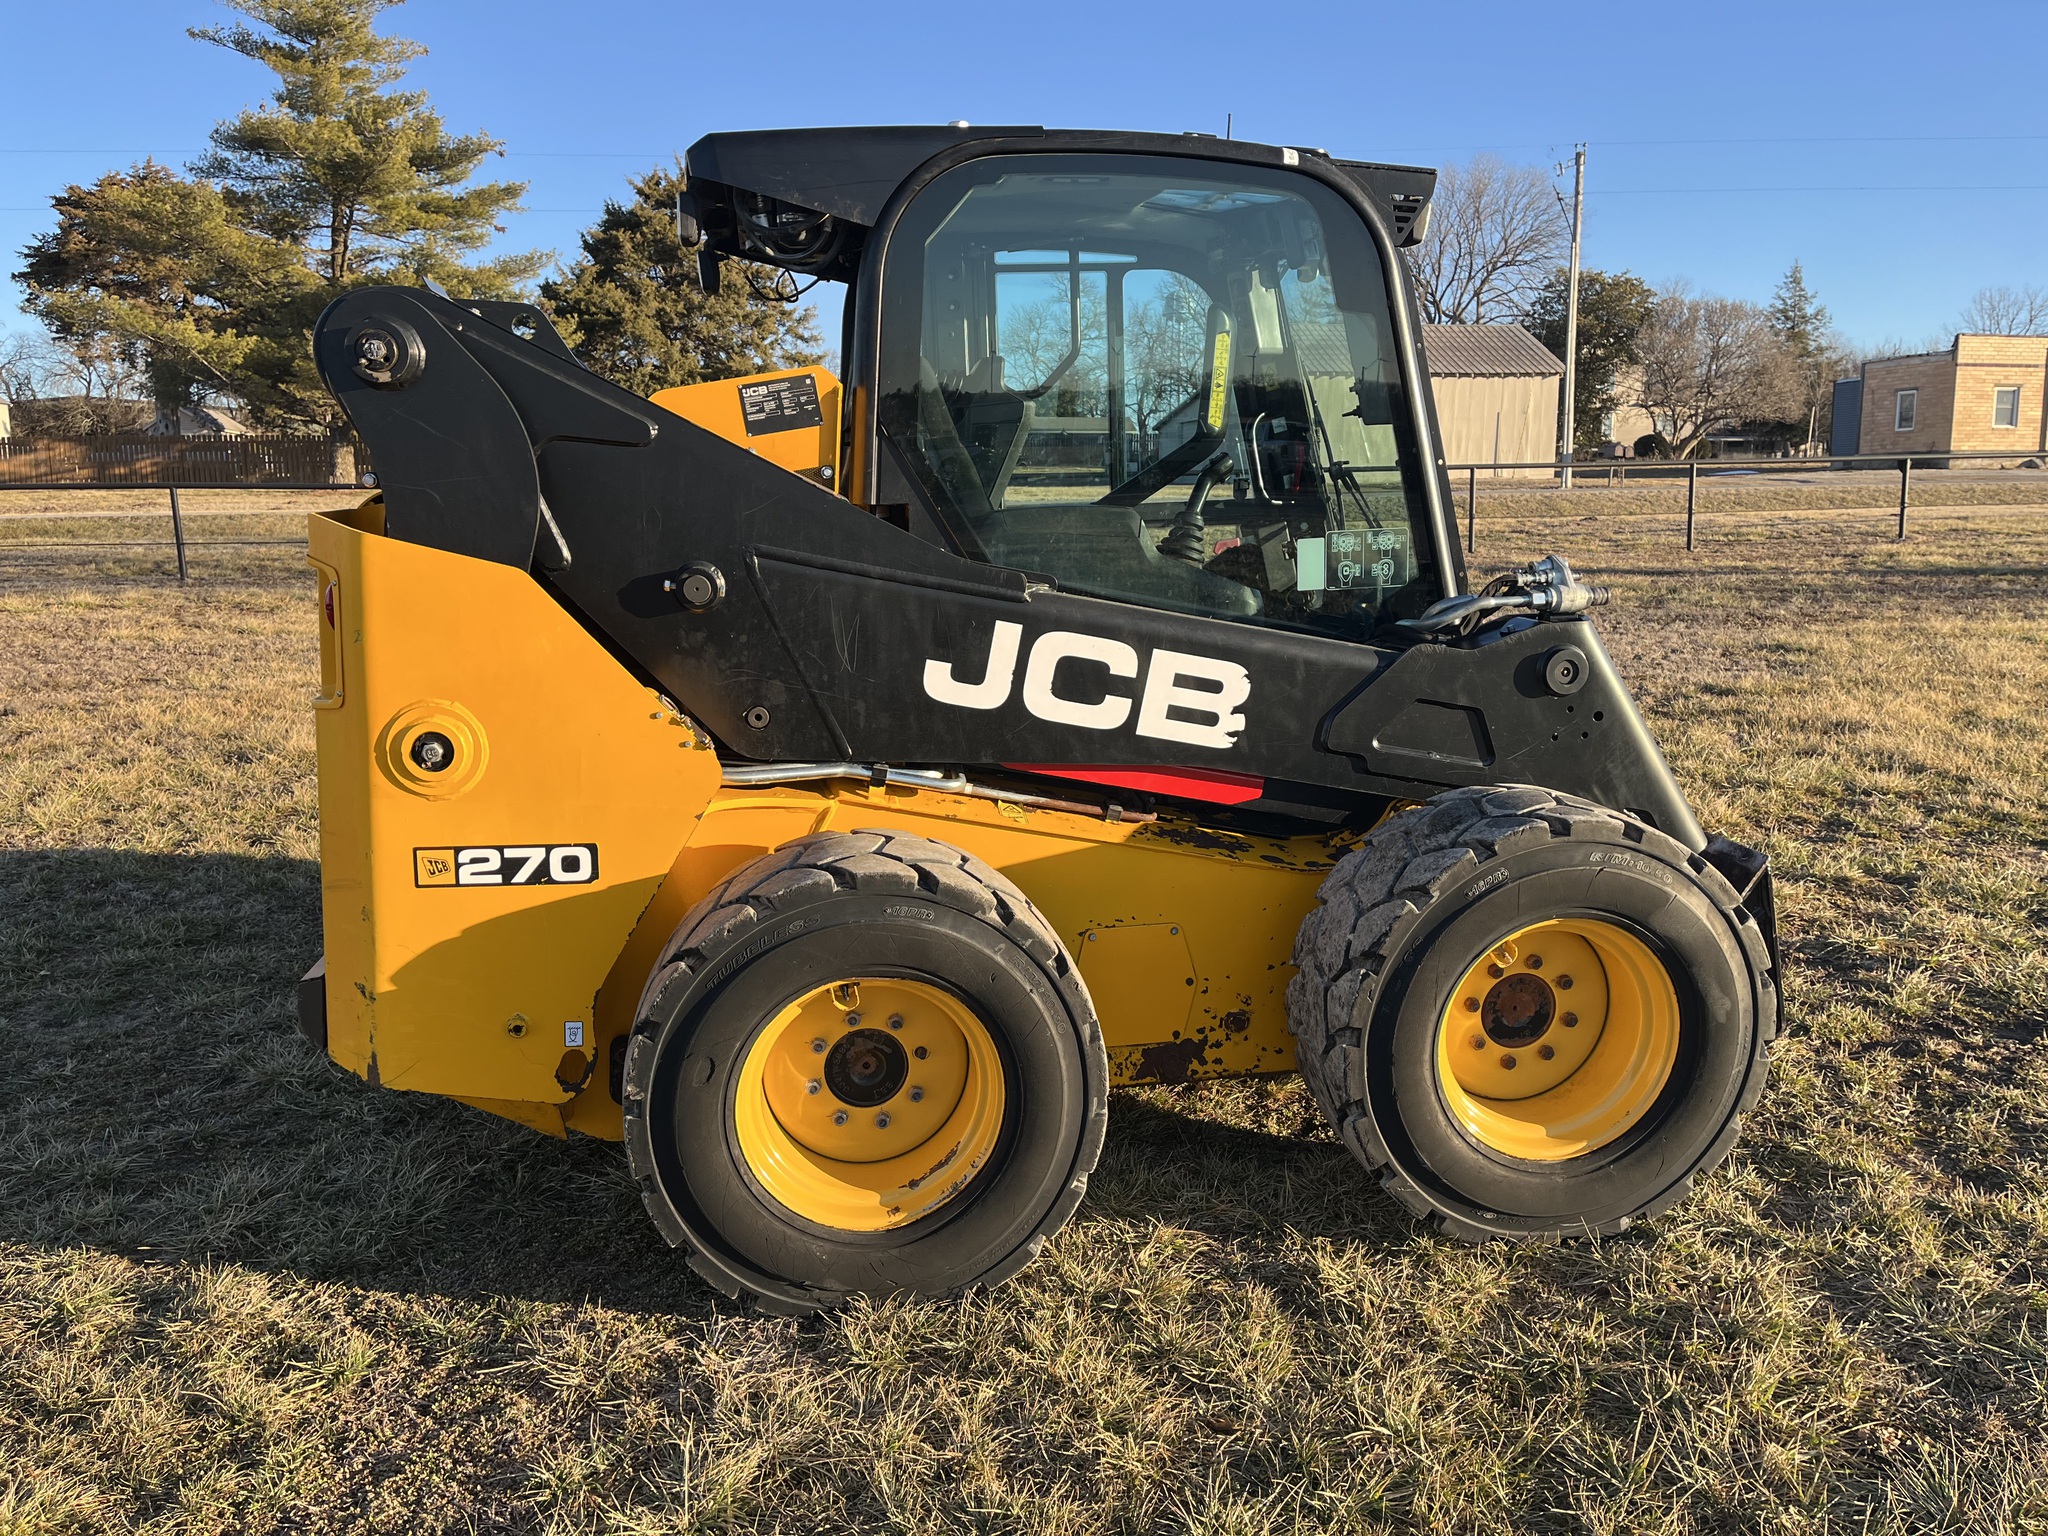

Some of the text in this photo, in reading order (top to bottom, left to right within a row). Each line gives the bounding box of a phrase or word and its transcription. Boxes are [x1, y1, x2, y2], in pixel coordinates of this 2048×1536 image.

[742, 385, 768, 397] JCB
[923, 620, 1251, 748] JCB
[427, 858, 449, 876] JCB
[458, 846, 592, 885] 270
[706, 914, 820, 989] TUBELESS
